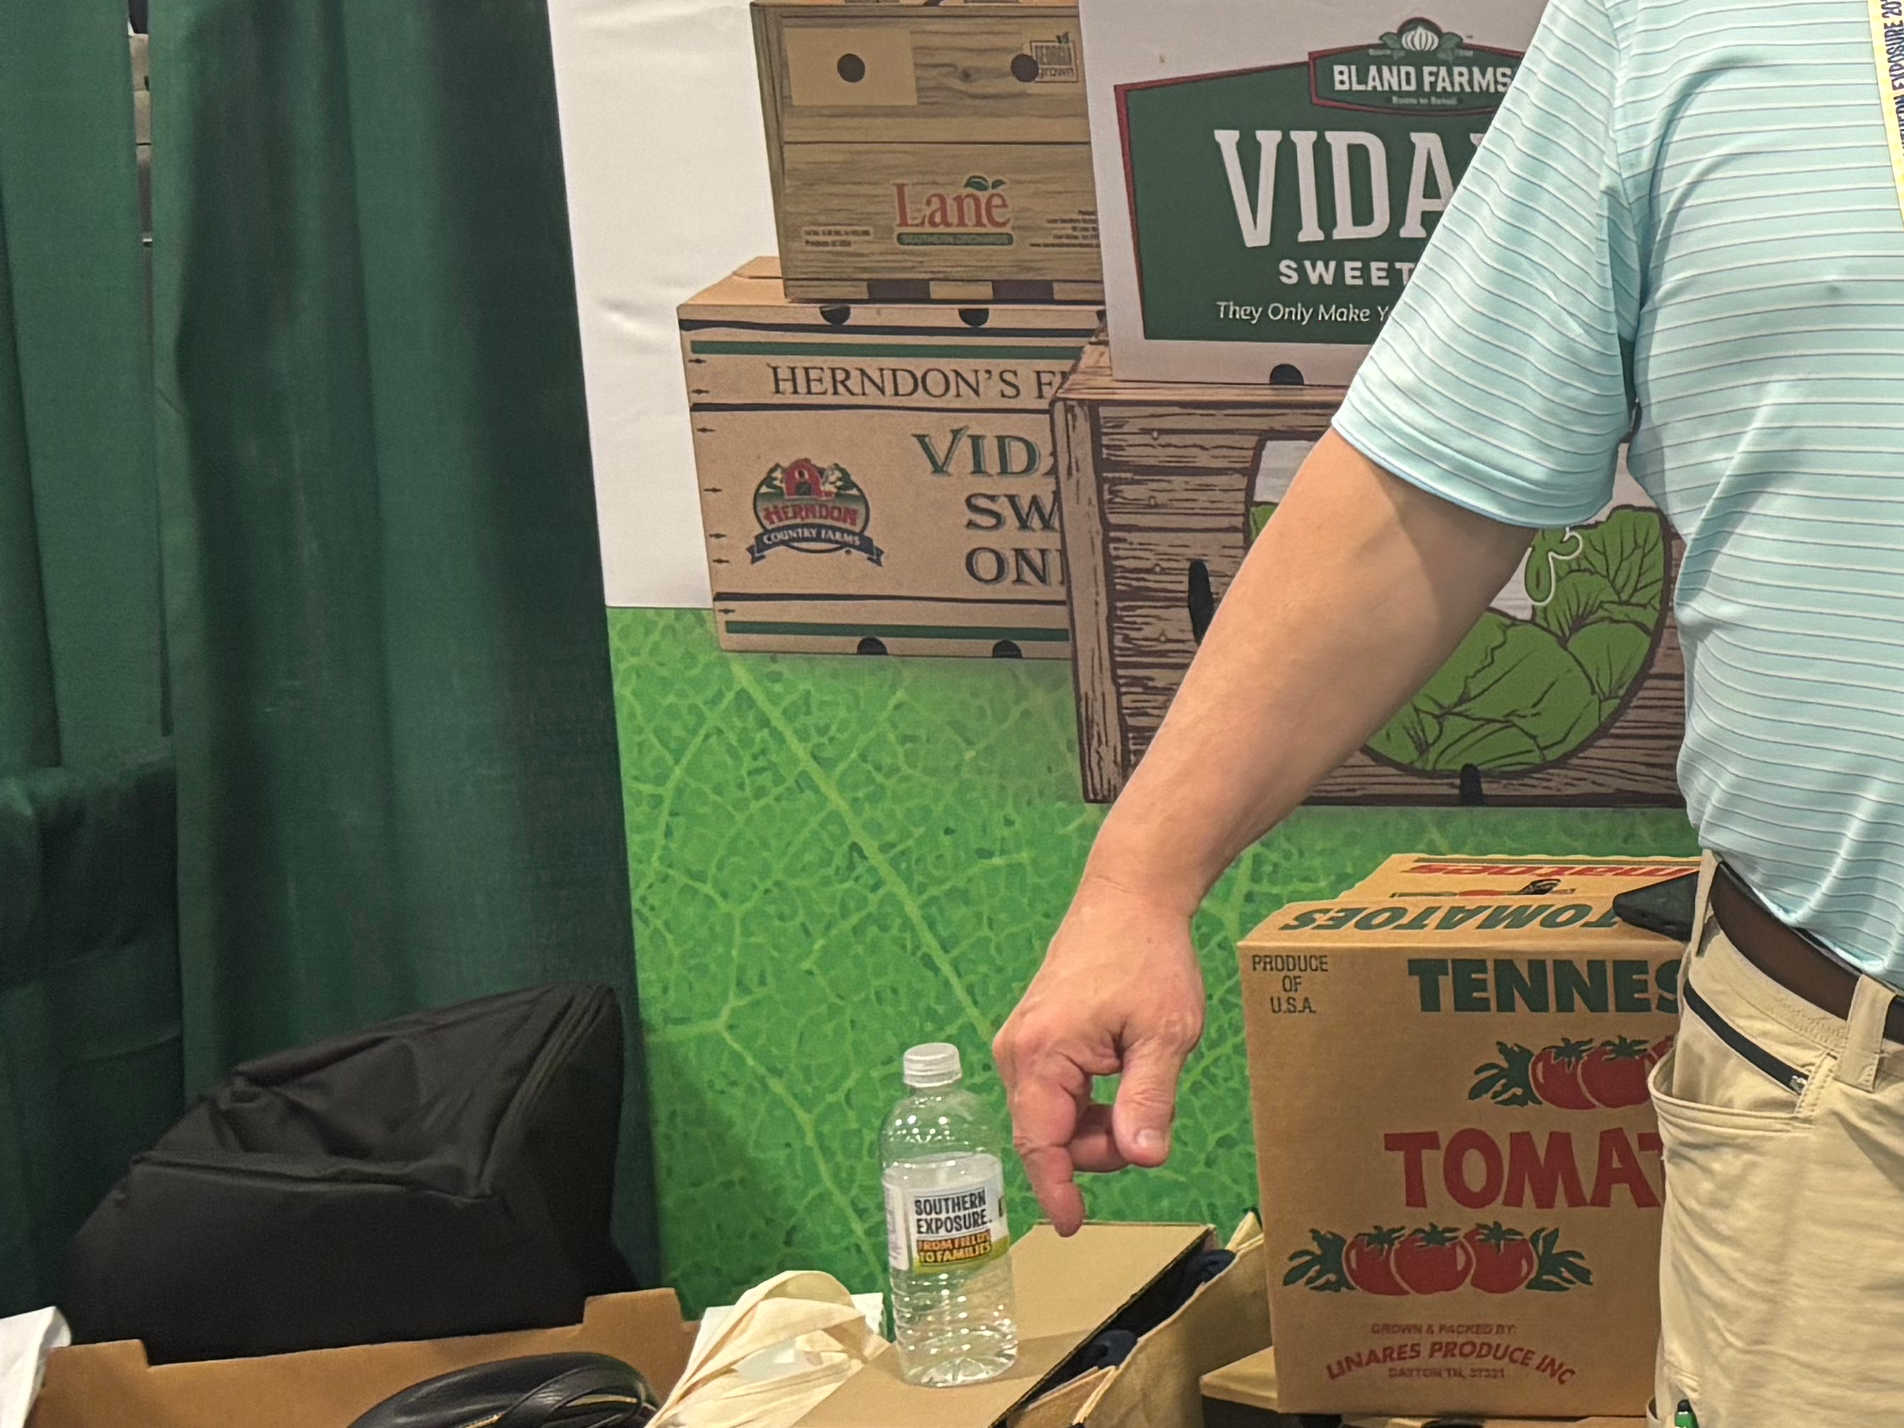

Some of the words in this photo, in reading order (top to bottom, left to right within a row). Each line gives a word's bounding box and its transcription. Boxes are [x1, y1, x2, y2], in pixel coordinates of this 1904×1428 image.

[1333, 64, 1416, 93] BLAND
[1422, 65, 1515, 93] FARMS
[1214, 129, 1489, 248] VIDA
[1278, 259, 1420, 286] SWEET
[1216, 301, 1262, 324] They
[1267, 302, 1313, 326] Only
[1318, 303, 1371, 323] Make
[767, 362, 1022, 399] HERNDON'S
[912, 425, 1058, 477] VID
[763, 505, 859, 526] HERNDON
[762, 527, 818, 546] COUNTRY
[820, 527, 861, 546] FARMS
[1251, 953, 1328, 973] PRODUCE
[1281, 975, 1302, 993] OF
[1270, 995, 1316, 1014] U.S.A.
[914, 1190, 987, 1217] SOUTHERN
[916, 1237, 951, 1252] FROM
[953, 1229, 992, 1248] FIELDS
[917, 1251, 934, 1264] TO
[935, 1243, 992, 1262] FAMILIES
[1325, 1342, 1421, 1381] LINARES
[1428, 1340, 1536, 1367] PRODUCE
[1536, 1354, 1576, 1386] INC
